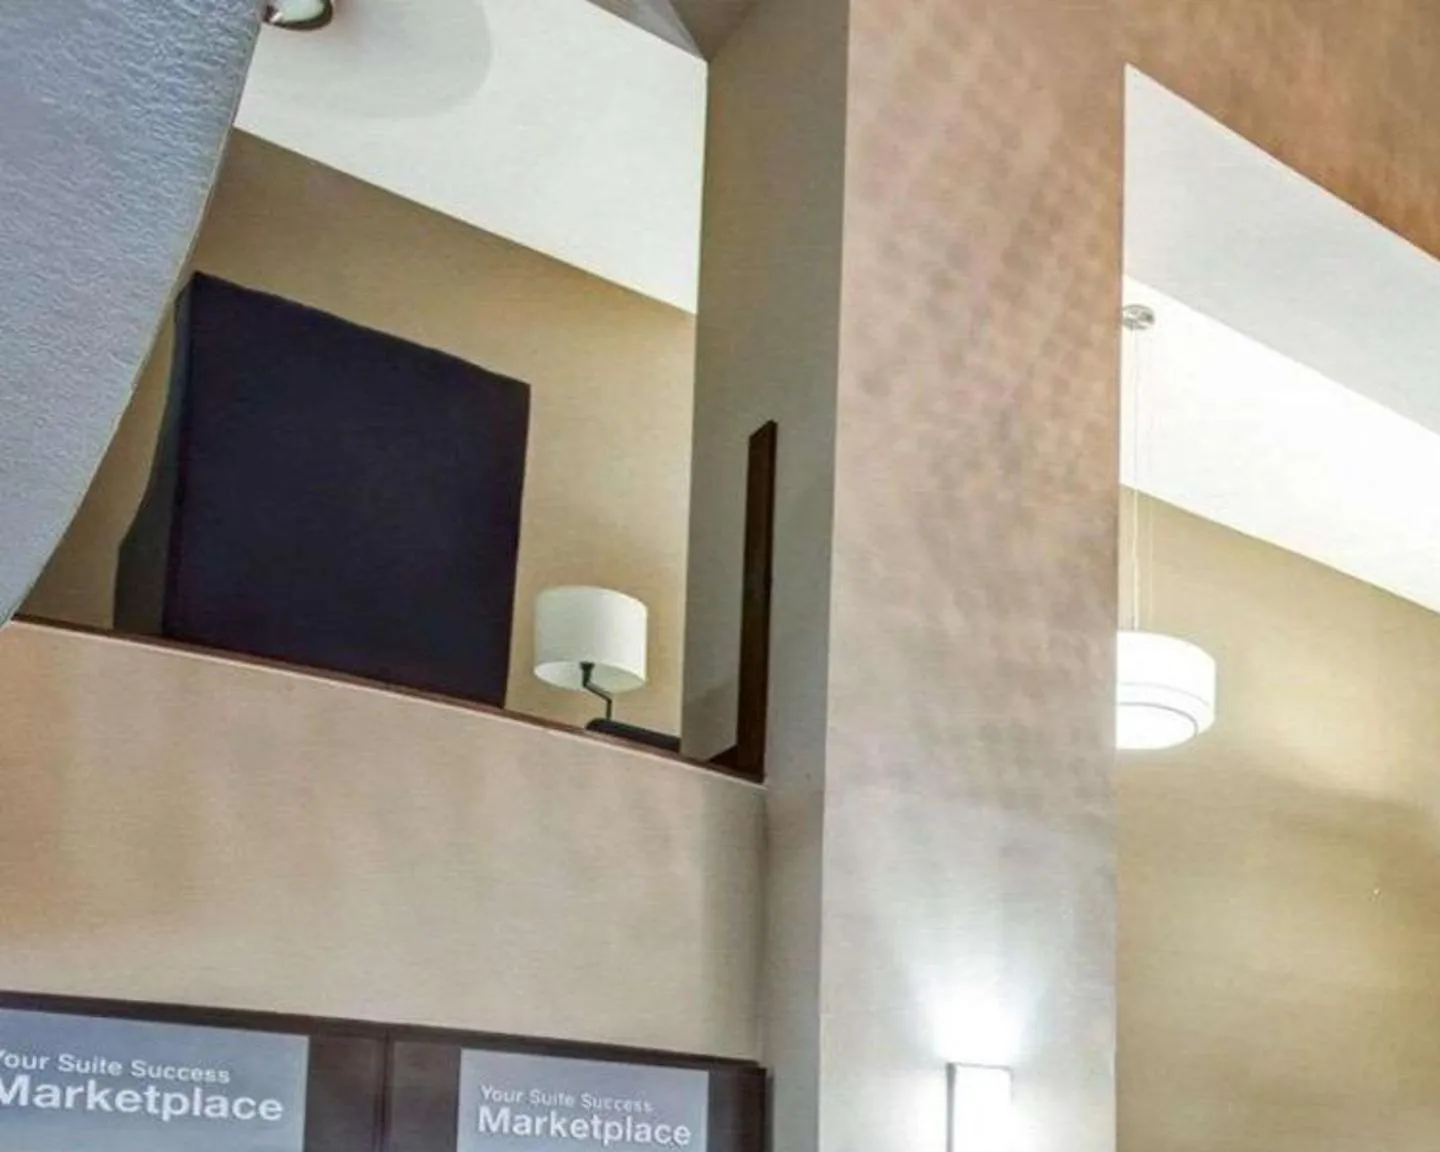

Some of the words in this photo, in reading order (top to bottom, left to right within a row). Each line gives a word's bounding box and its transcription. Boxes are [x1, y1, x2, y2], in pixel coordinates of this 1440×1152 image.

[0, 1052, 50, 1070] our
[57, 1053, 123, 1076] Suite
[130, 1060, 231, 1084] Success
[0, 1073, 284, 1122] Marketplace
[480, 1084, 523, 1103] Your
[528, 1088, 575, 1108] Suite
[581, 1093, 654, 1113] Success
[477, 1105, 692, 1146] Marketplace
